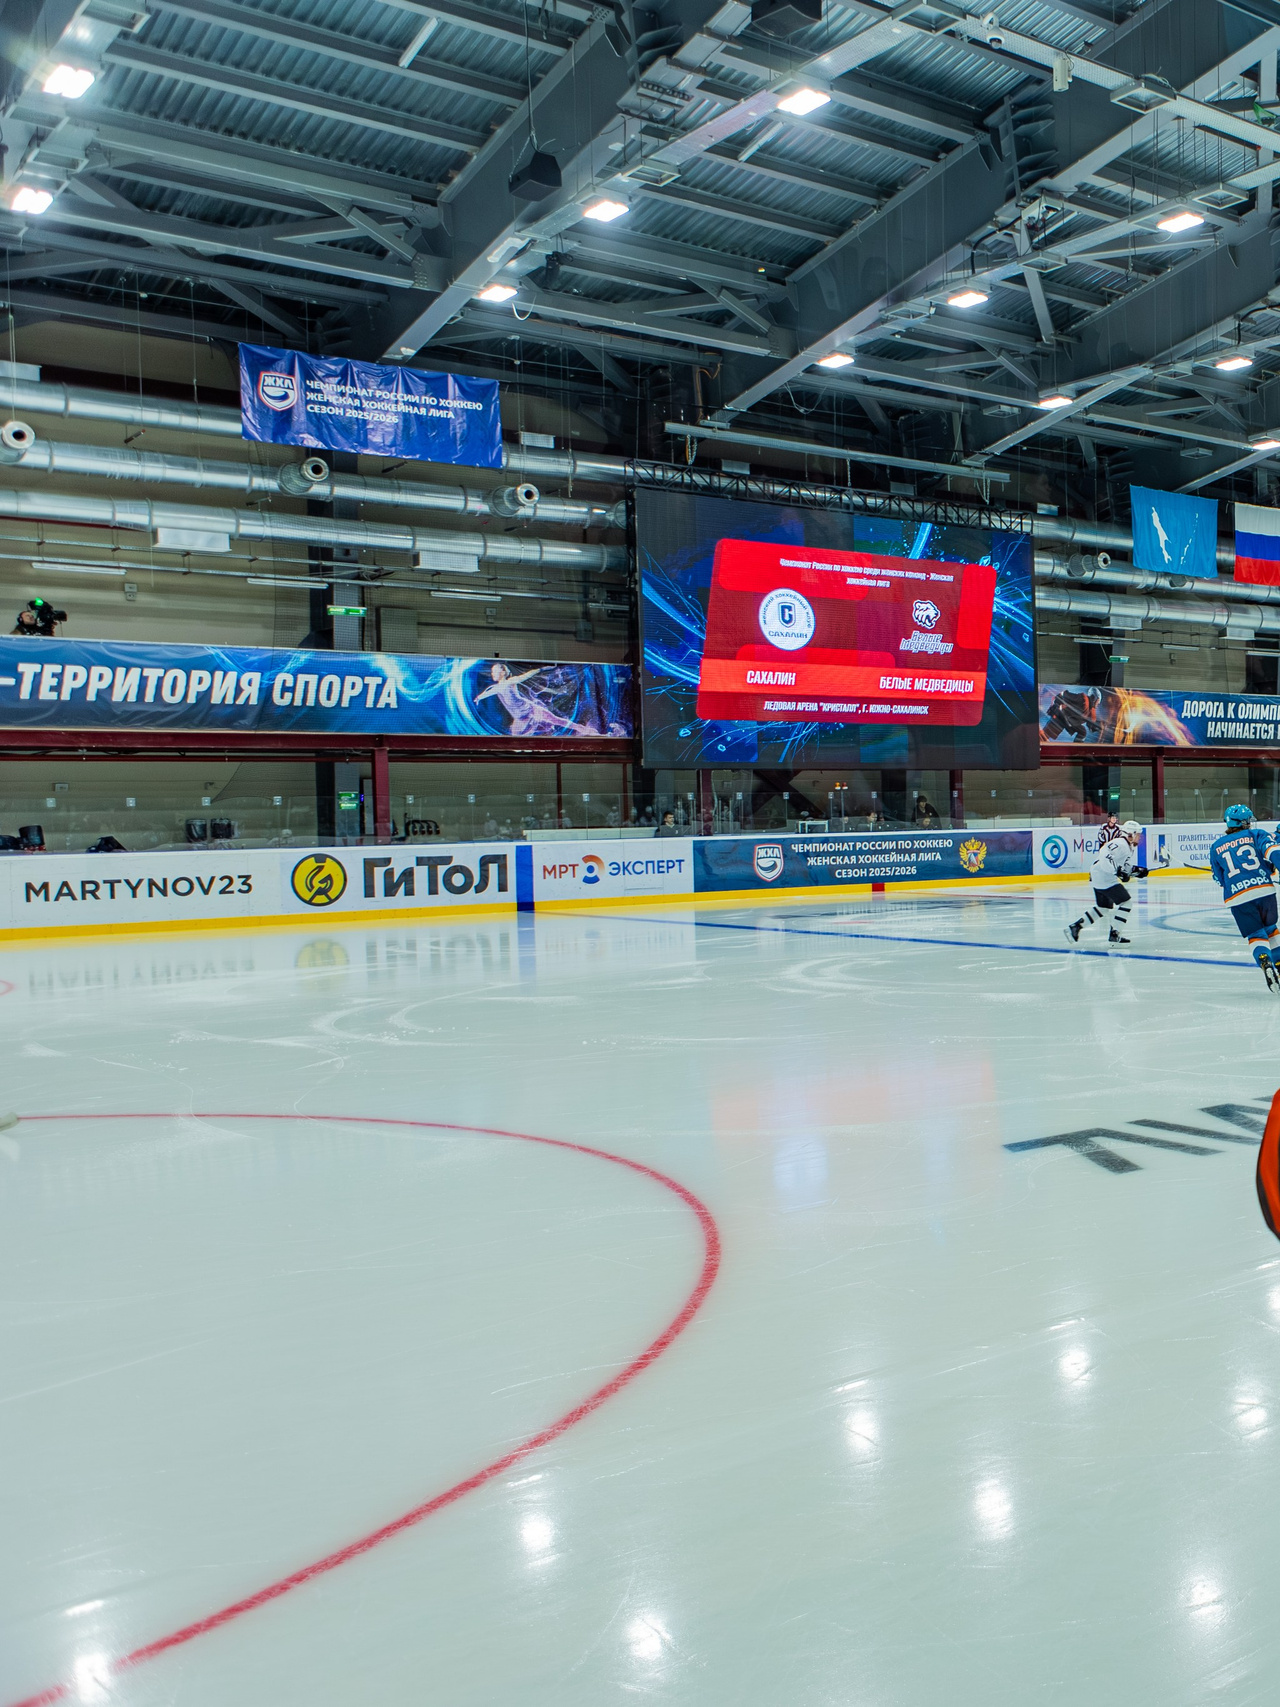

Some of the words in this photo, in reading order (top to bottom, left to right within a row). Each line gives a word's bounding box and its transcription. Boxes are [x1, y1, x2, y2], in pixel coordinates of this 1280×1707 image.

[263, 376, 293, 388] ЖХЛ
[306, 380, 374, 397] ЧЕМПИОНАТ
[375, 391, 420, 402] РОССИИ
[422, 396, 437, 405] ПО
[439, 398, 483, 411] ХОККЕЮ
[306, 391, 361, 407] ЖЕНСКАЯ
[362, 399, 426, 416] ХОККЕЙНАЯ
[428, 409, 455, 419] ЛИГА
[306, 404, 344, 416] СЕЗОН
[345, 409, 399, 423] 2025/2026
[746, 670, 796, 686] САХАЛИН
[879, 676, 912, 690] БЕЛЫЕ
[913, 678, 974, 693] МЕДВЕДИЦЫ
[271, 674, 398, 708] СПОРТА
[763, 701, 796, 712] ЛЕДОВАЯ
[797, 702, 818, 712] АРЕНА
[869, 705, 929, 715] ЮЖНО-САХАЛИНСК
[1181, 700, 1224, 718] ДОРОГА
[1226, 703, 1234, 717] К
[1207, 721, 1275, 740] НАЧИНАЕТСЯ
[791, 841, 856, 853] ЧЕМПИОНАТ
[857, 840, 898, 851] РОССИИ
[899, 840, 912, 849] ПО
[913, 838, 953, 849] ХОККЕЮ
[1215, 837, 1255, 855] ПИРОГОВА
[757, 850, 781, 859] ЖХЛ
[806, 855, 857, 866] ЖЕНСКАЯ
[858, 851, 917, 864] ХОККЕЙНАЯ
[918, 851, 942, 862] ЛИГА
[1221, 844, 1261, 879] 13
[542, 863, 579, 880] МРТ
[608, 859, 685, 876] ЭКСПЕРТ
[835, 868, 868, 879] СЕЗОН
[868, 865, 917, 877] 2025/2026
[24, 874, 253, 902] MARTYNOV23
